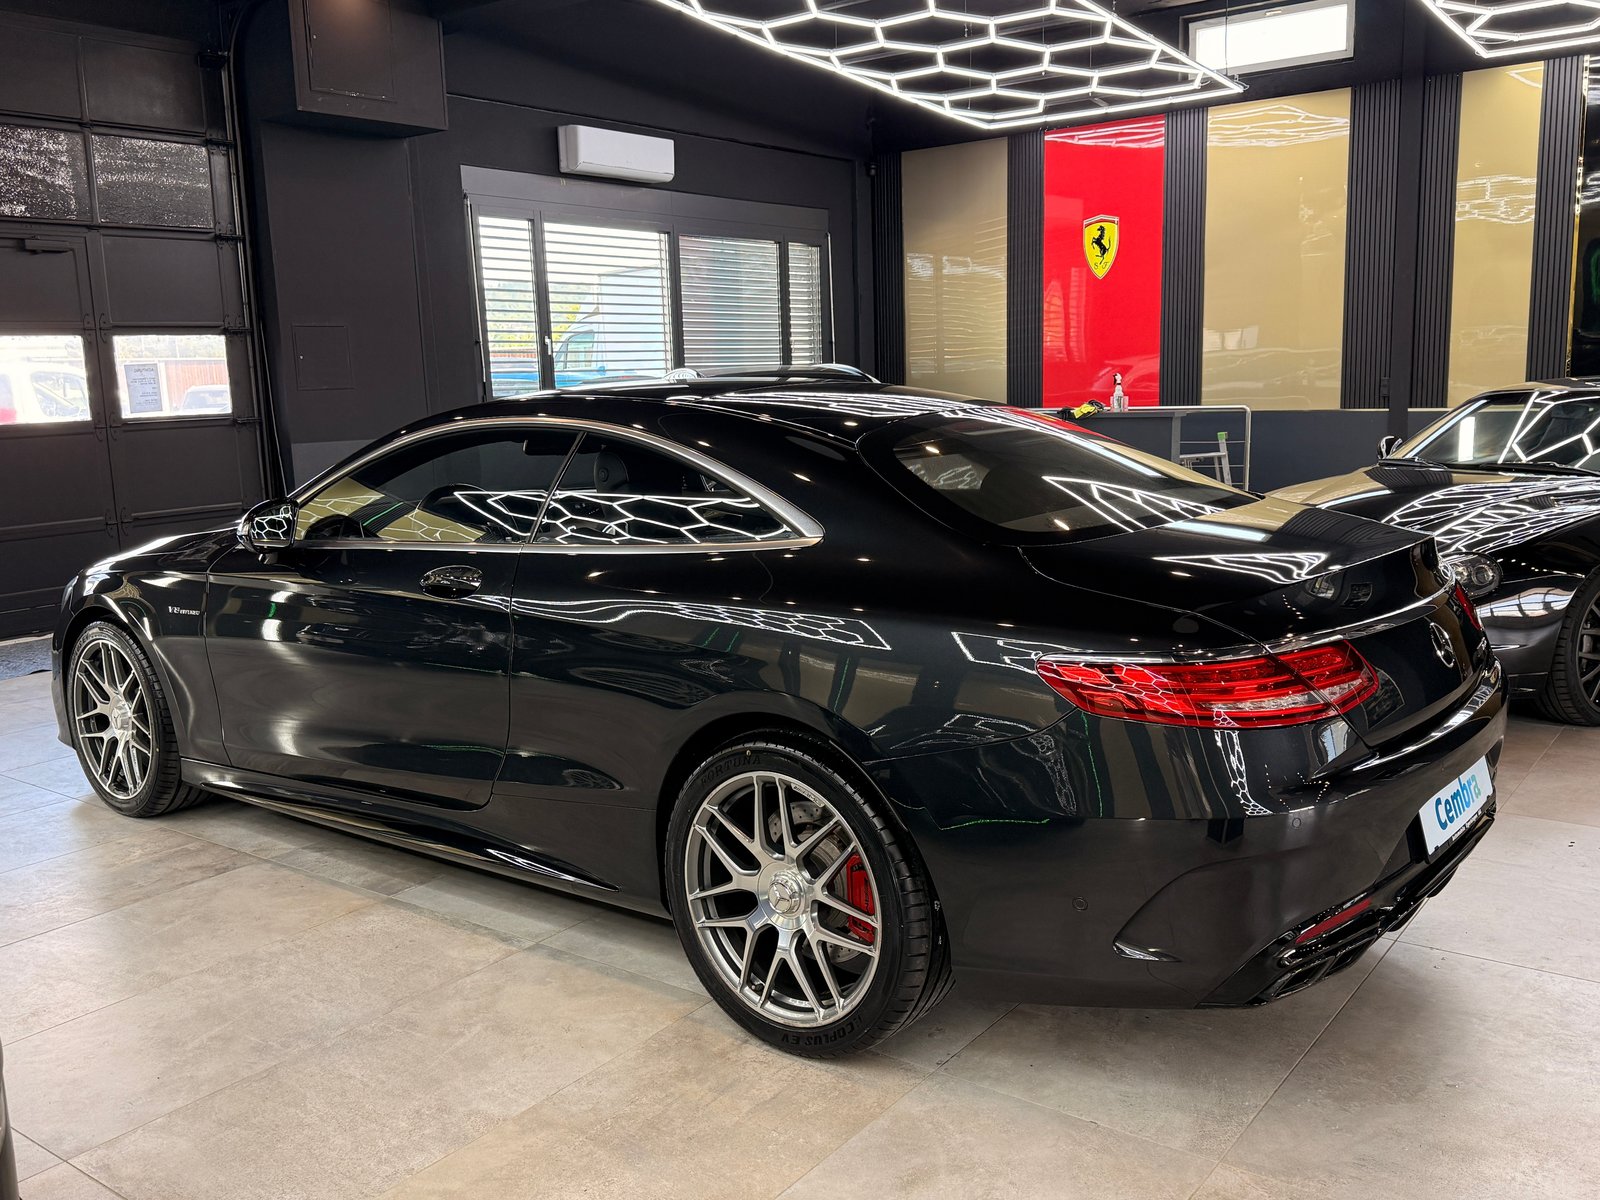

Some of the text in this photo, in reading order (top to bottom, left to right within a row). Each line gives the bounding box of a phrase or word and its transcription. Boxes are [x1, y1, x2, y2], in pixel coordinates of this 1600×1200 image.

[700, 754, 761, 787] FORTUNA
[1434, 774, 1482, 831] Cembra
[782, 1032, 800, 1045] EV
